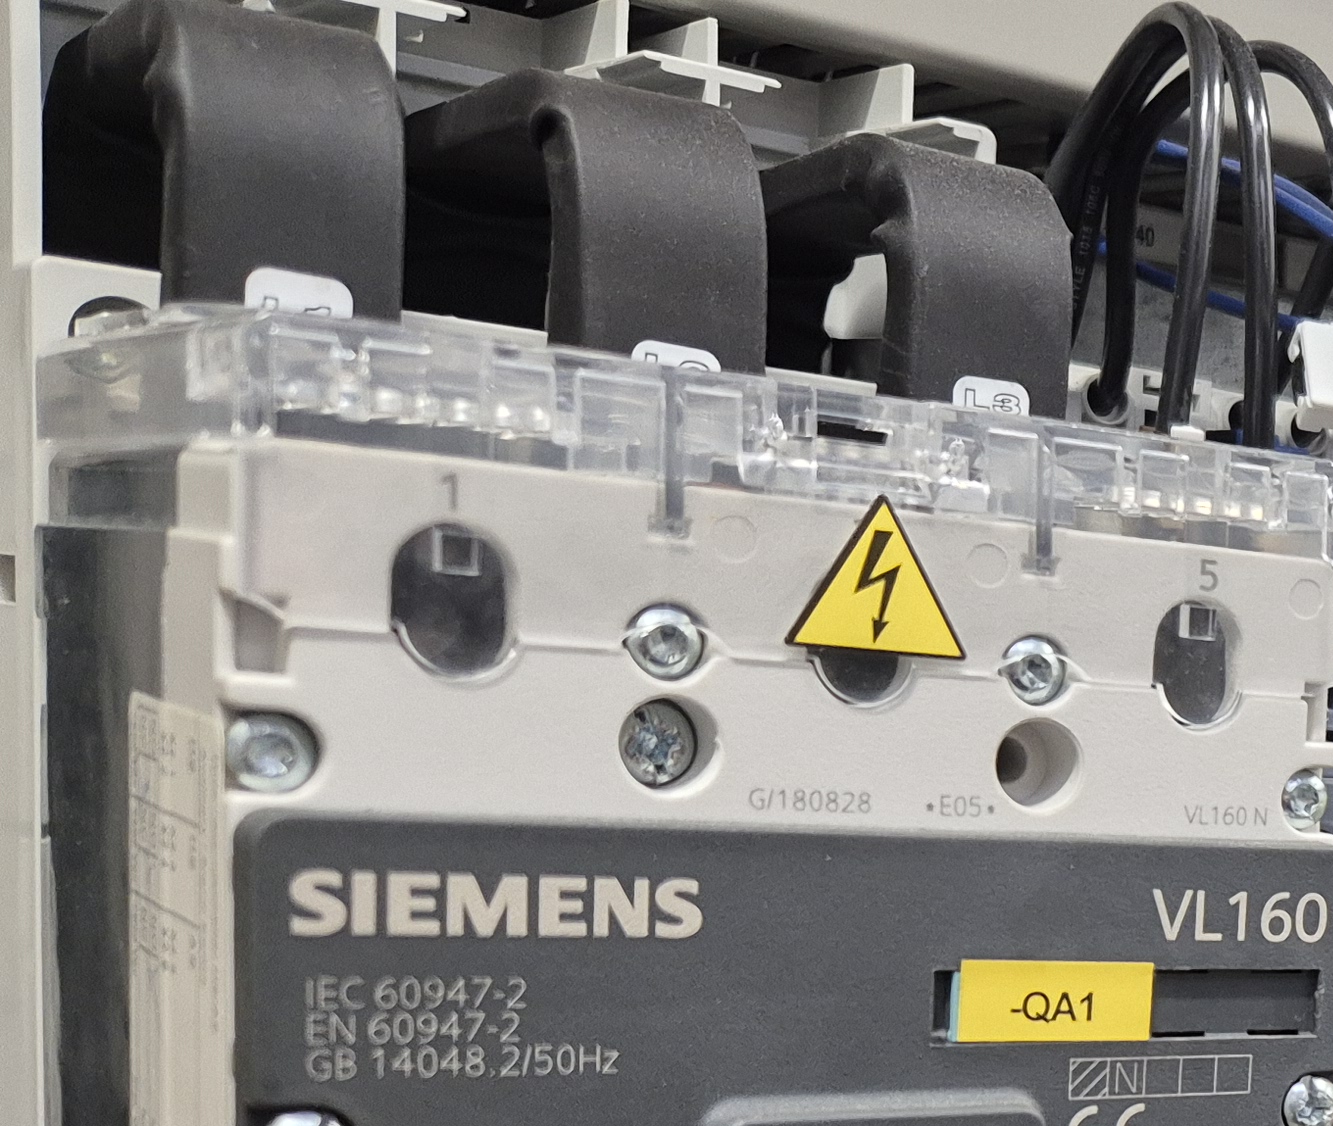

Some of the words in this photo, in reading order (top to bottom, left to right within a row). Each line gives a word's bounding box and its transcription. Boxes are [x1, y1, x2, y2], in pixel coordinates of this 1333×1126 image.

[440, 472, 461, 511] 1
[1201, 559, 1218, 591] 5
[747, 787, 873, 816] G/180828
[1184, 803, 1248, 828] VL160
[1252, 805, 1269, 829] N
[287, 867, 703, 939] SIEMENS
[1152, 888, 1329, 944] VL160
[303, 975, 366, 1011] IEC
[372, 974, 529, 1012] 60947-2
[1009, 989, 1097, 1024] -QA1
[303, 1013, 358, 1046] EN
[366, 1009, 522, 1044] 60947-2
[303, 1046, 359, 1082] GB
[371, 1041, 621, 1079] 14048.2/50Hz
[1113, 1061, 1140, 1094] N
